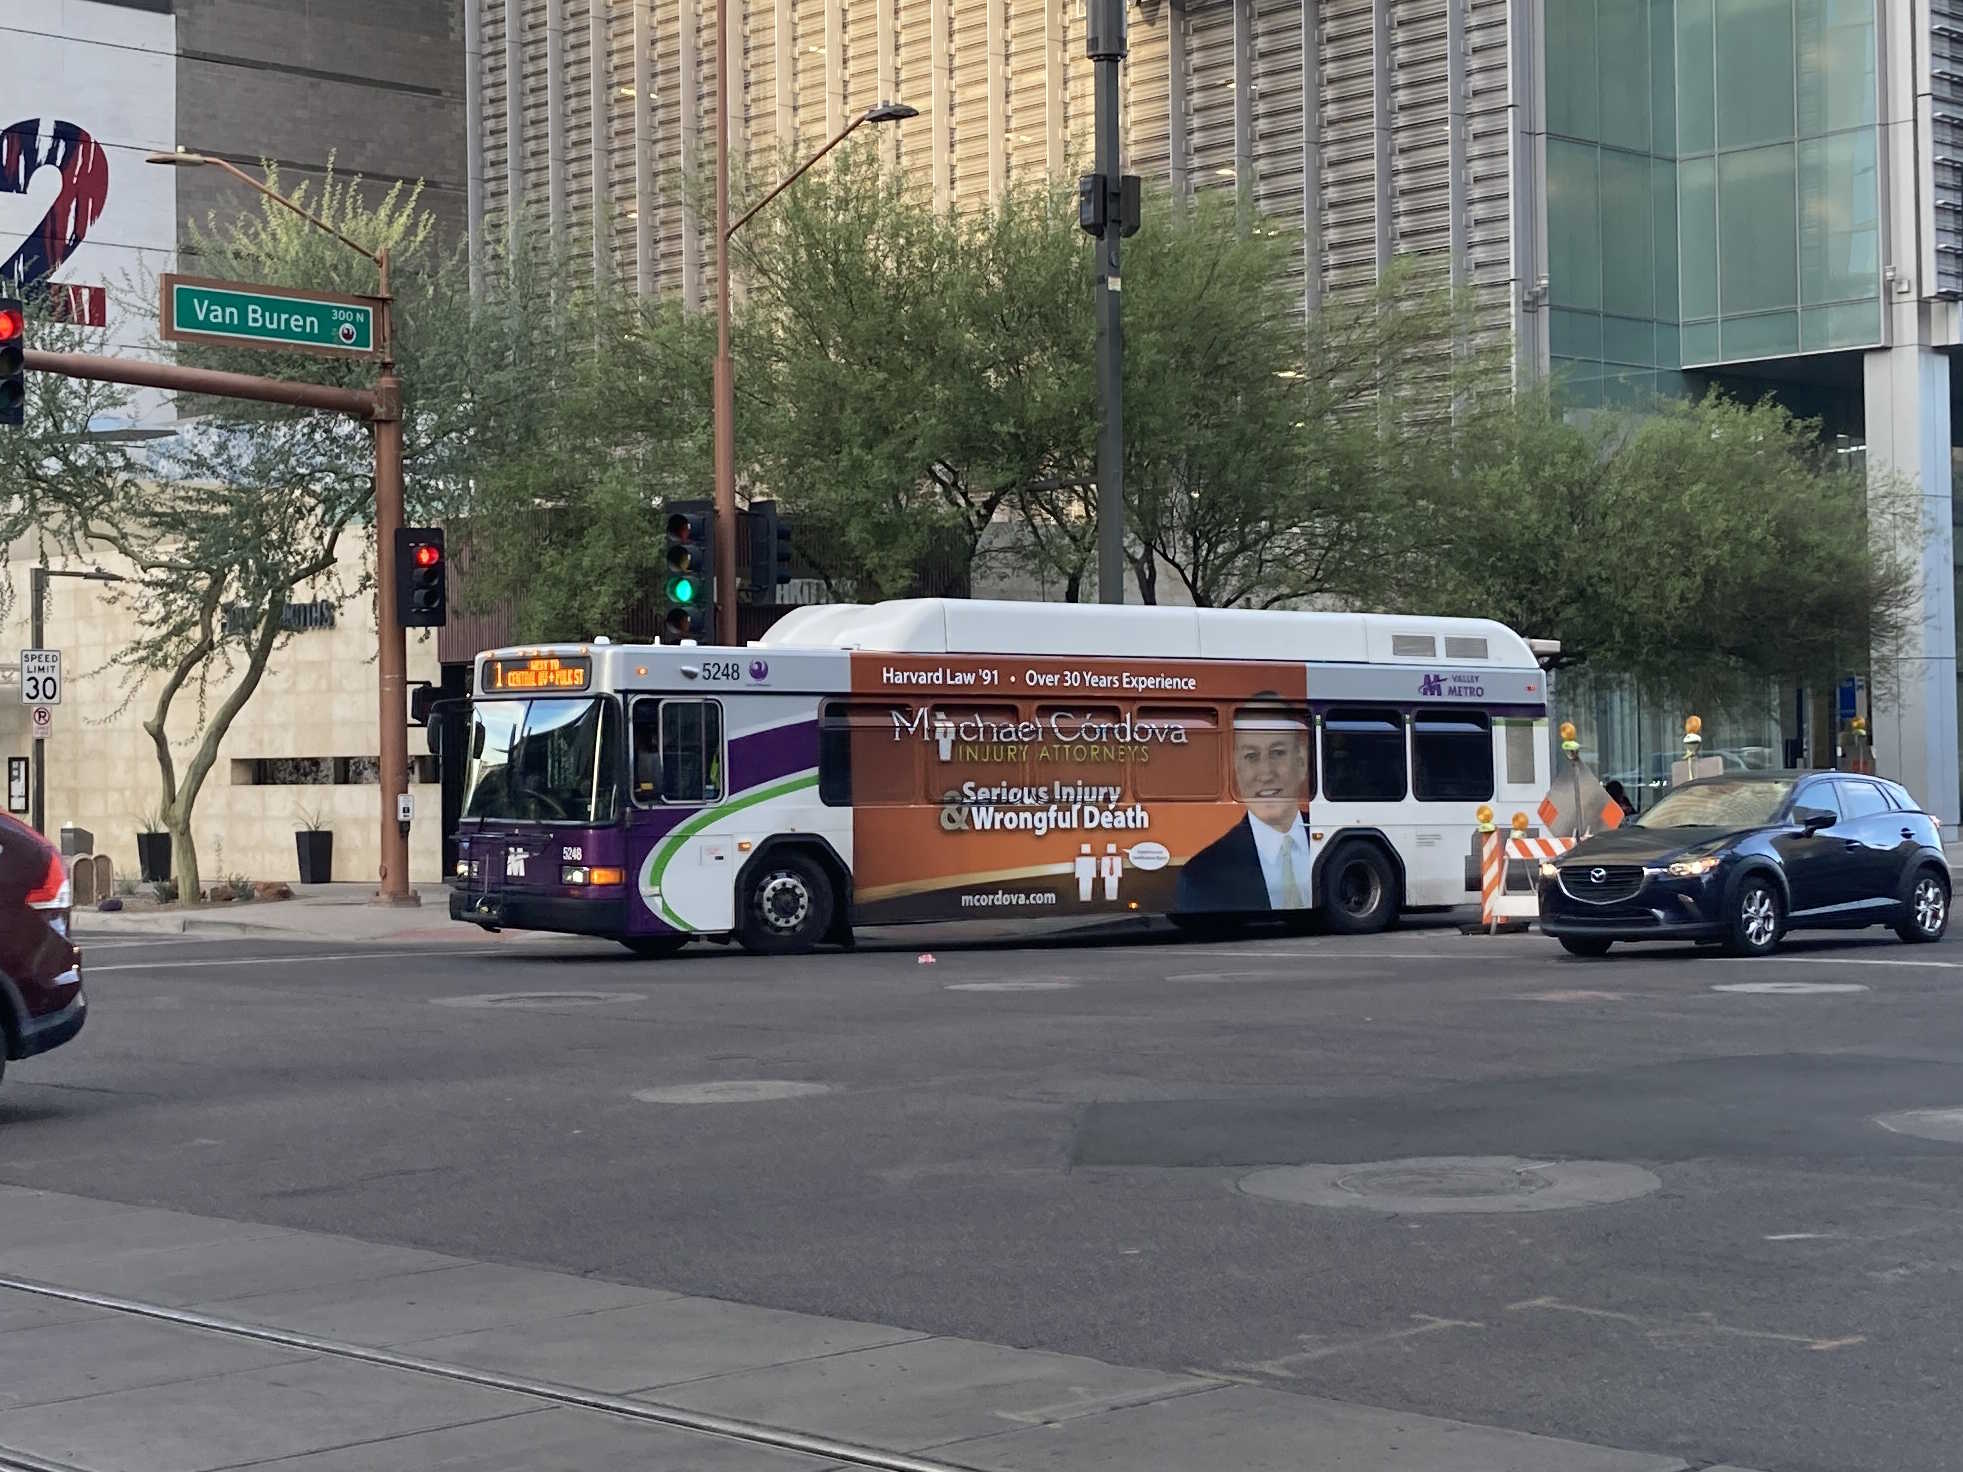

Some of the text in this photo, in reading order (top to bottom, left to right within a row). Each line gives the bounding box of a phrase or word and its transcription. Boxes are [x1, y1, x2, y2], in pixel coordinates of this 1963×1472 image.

[193, 298, 318, 334] Van Buren
[332, 309, 364, 323] 300 N
[24, 654, 58, 663] SPEED
[27, 665, 55, 674] LIMIT
[702, 662, 740, 681] 5248
[882, 667, 999, 685] Harvard Law '91
[26, 676, 57, 700] 30
[1025, 669, 1196, 692] Over 30 Years Experience
[1451, 675, 1480, 683] VALLEY
[1448, 686, 1484, 697] METRO
[890, 707, 1188, 761] Michael Córdova
[959, 744, 1150, 762] INJURY ATTORNEYS
[962, 780, 1121, 809] Serious Injury
[940, 790, 1149, 836] & Wrongful Death
[562, 847, 582, 860] 5248
[961, 890, 1056, 907] mcordova.com
